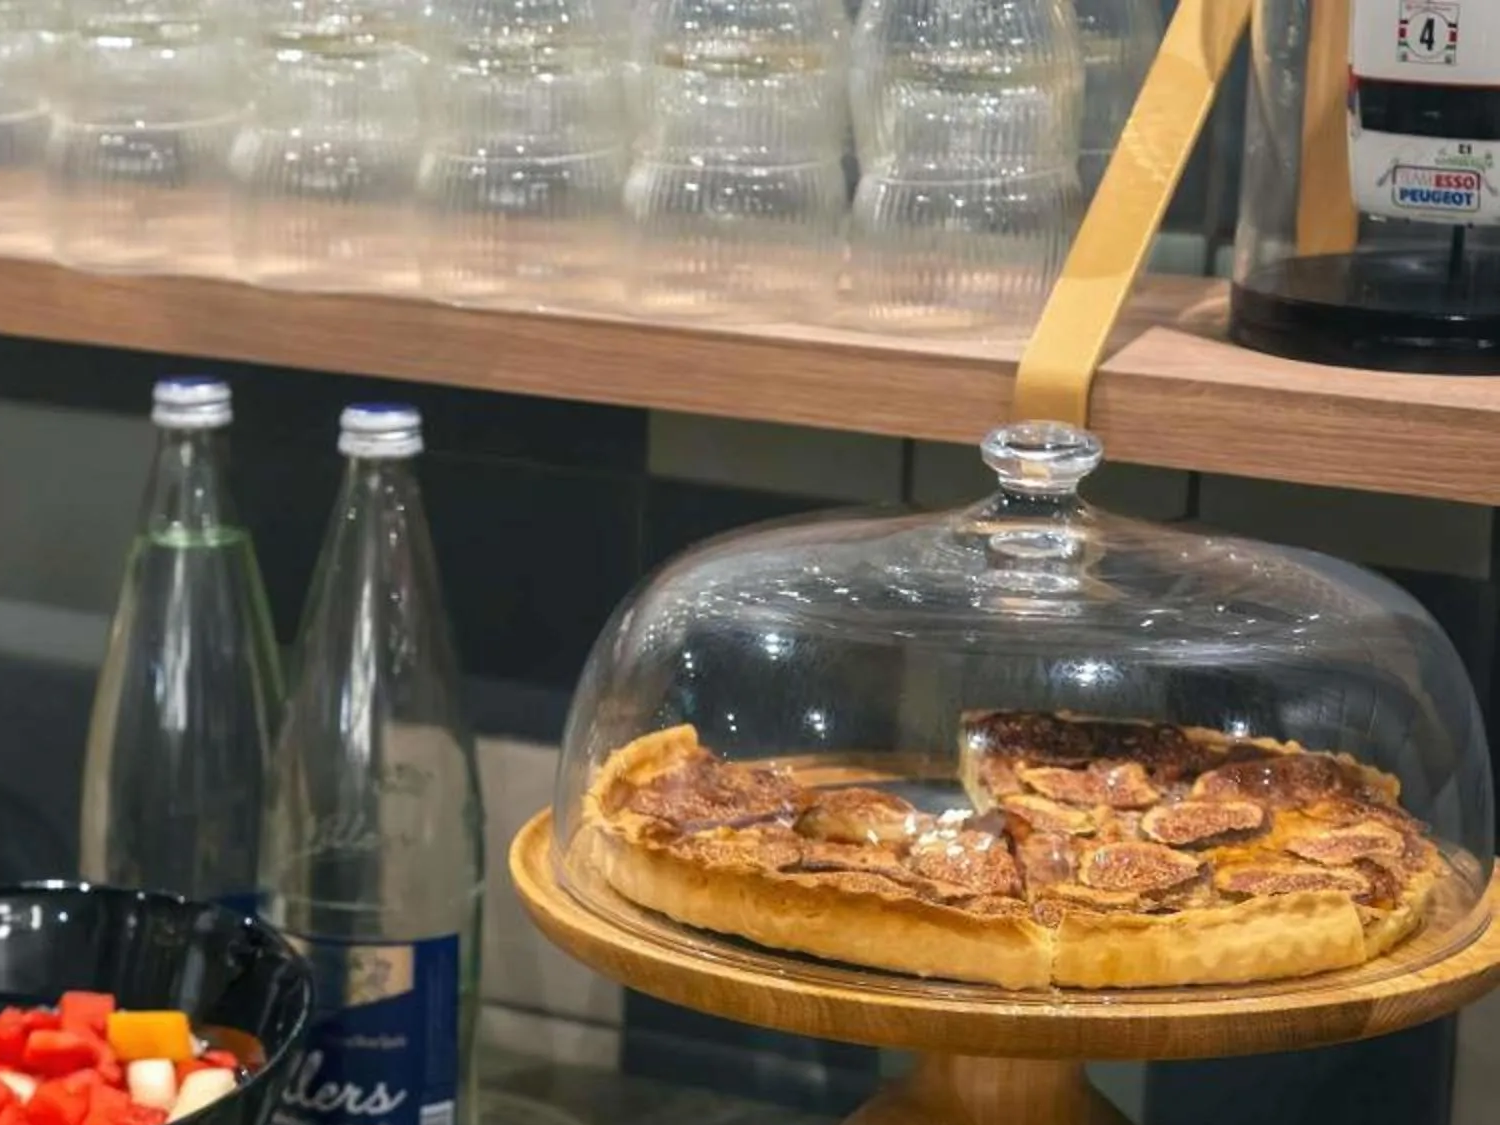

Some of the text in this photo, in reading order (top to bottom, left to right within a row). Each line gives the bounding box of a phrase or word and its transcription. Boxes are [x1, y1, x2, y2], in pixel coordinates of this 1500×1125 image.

[1419, 17, 1435, 51] 4
[1434, 173, 1475, 190] ESSO
[1399, 187, 1474, 206] PEUGEOT
